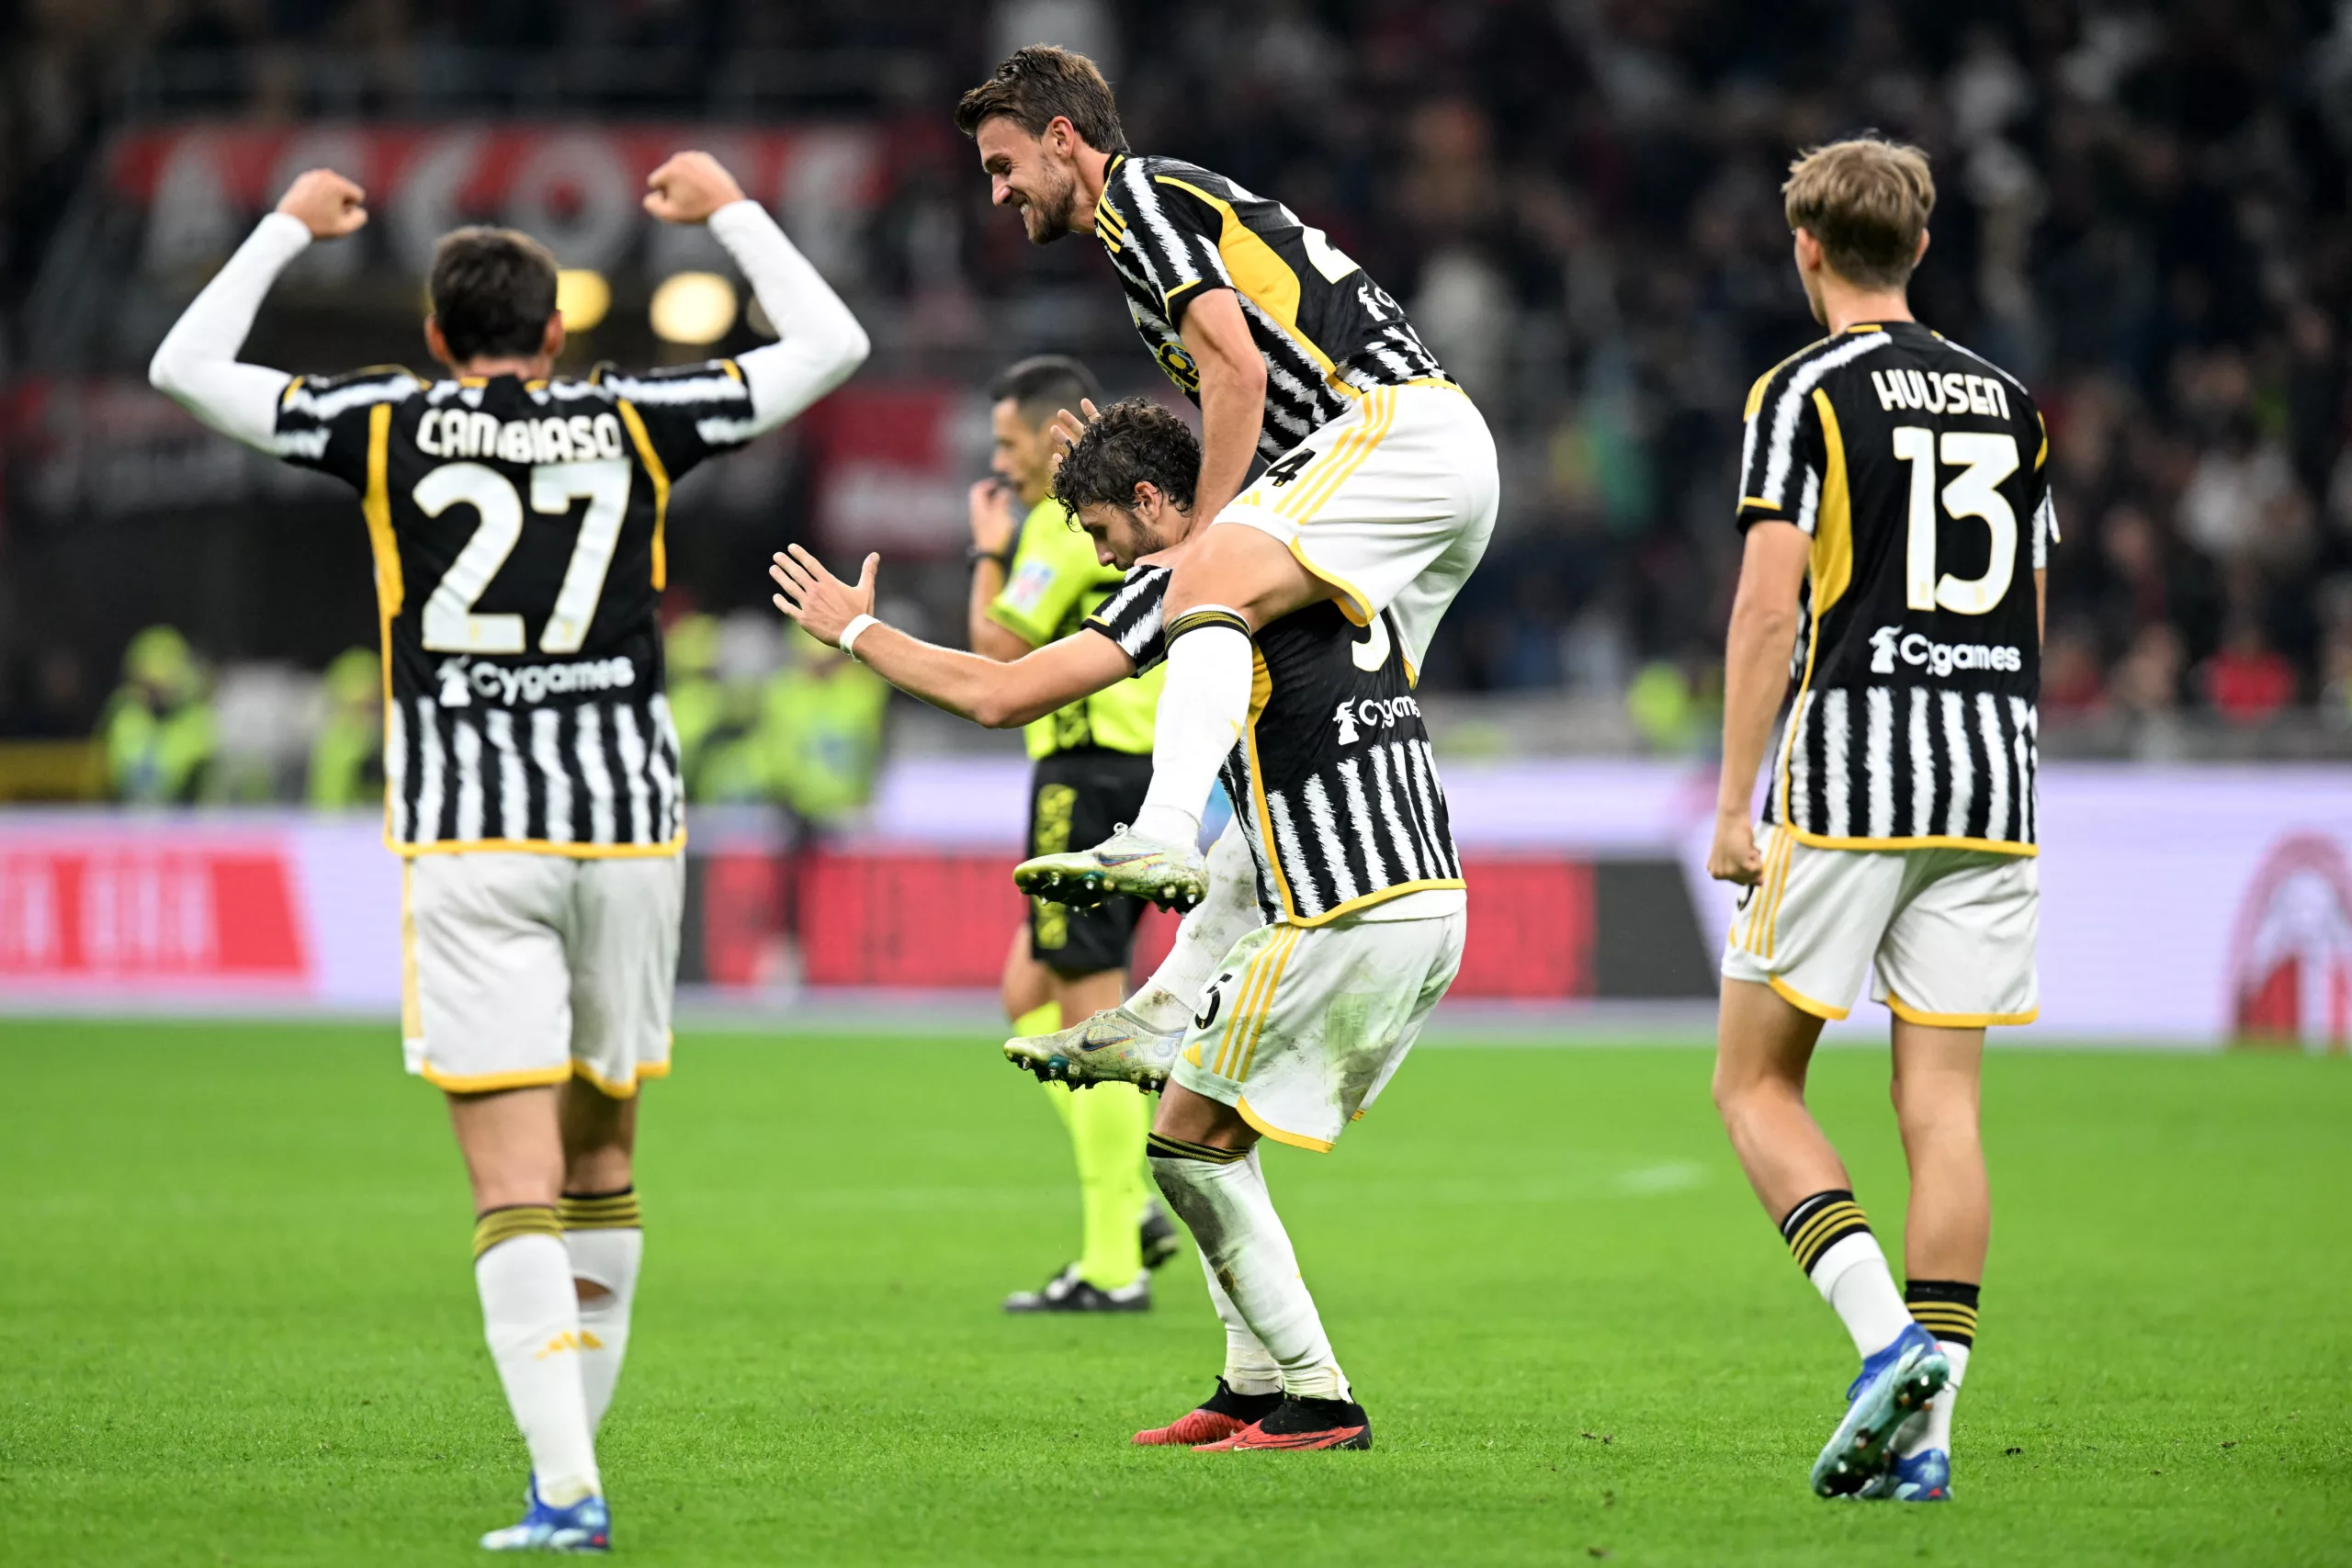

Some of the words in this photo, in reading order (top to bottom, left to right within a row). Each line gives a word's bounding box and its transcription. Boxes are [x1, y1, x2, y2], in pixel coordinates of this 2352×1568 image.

[415, 408, 624, 464] CAMBIASO
[413, 457, 632, 654] 27
[1893, 426, 2020, 615] 13
[1193, 973, 1233, 1030] 5
